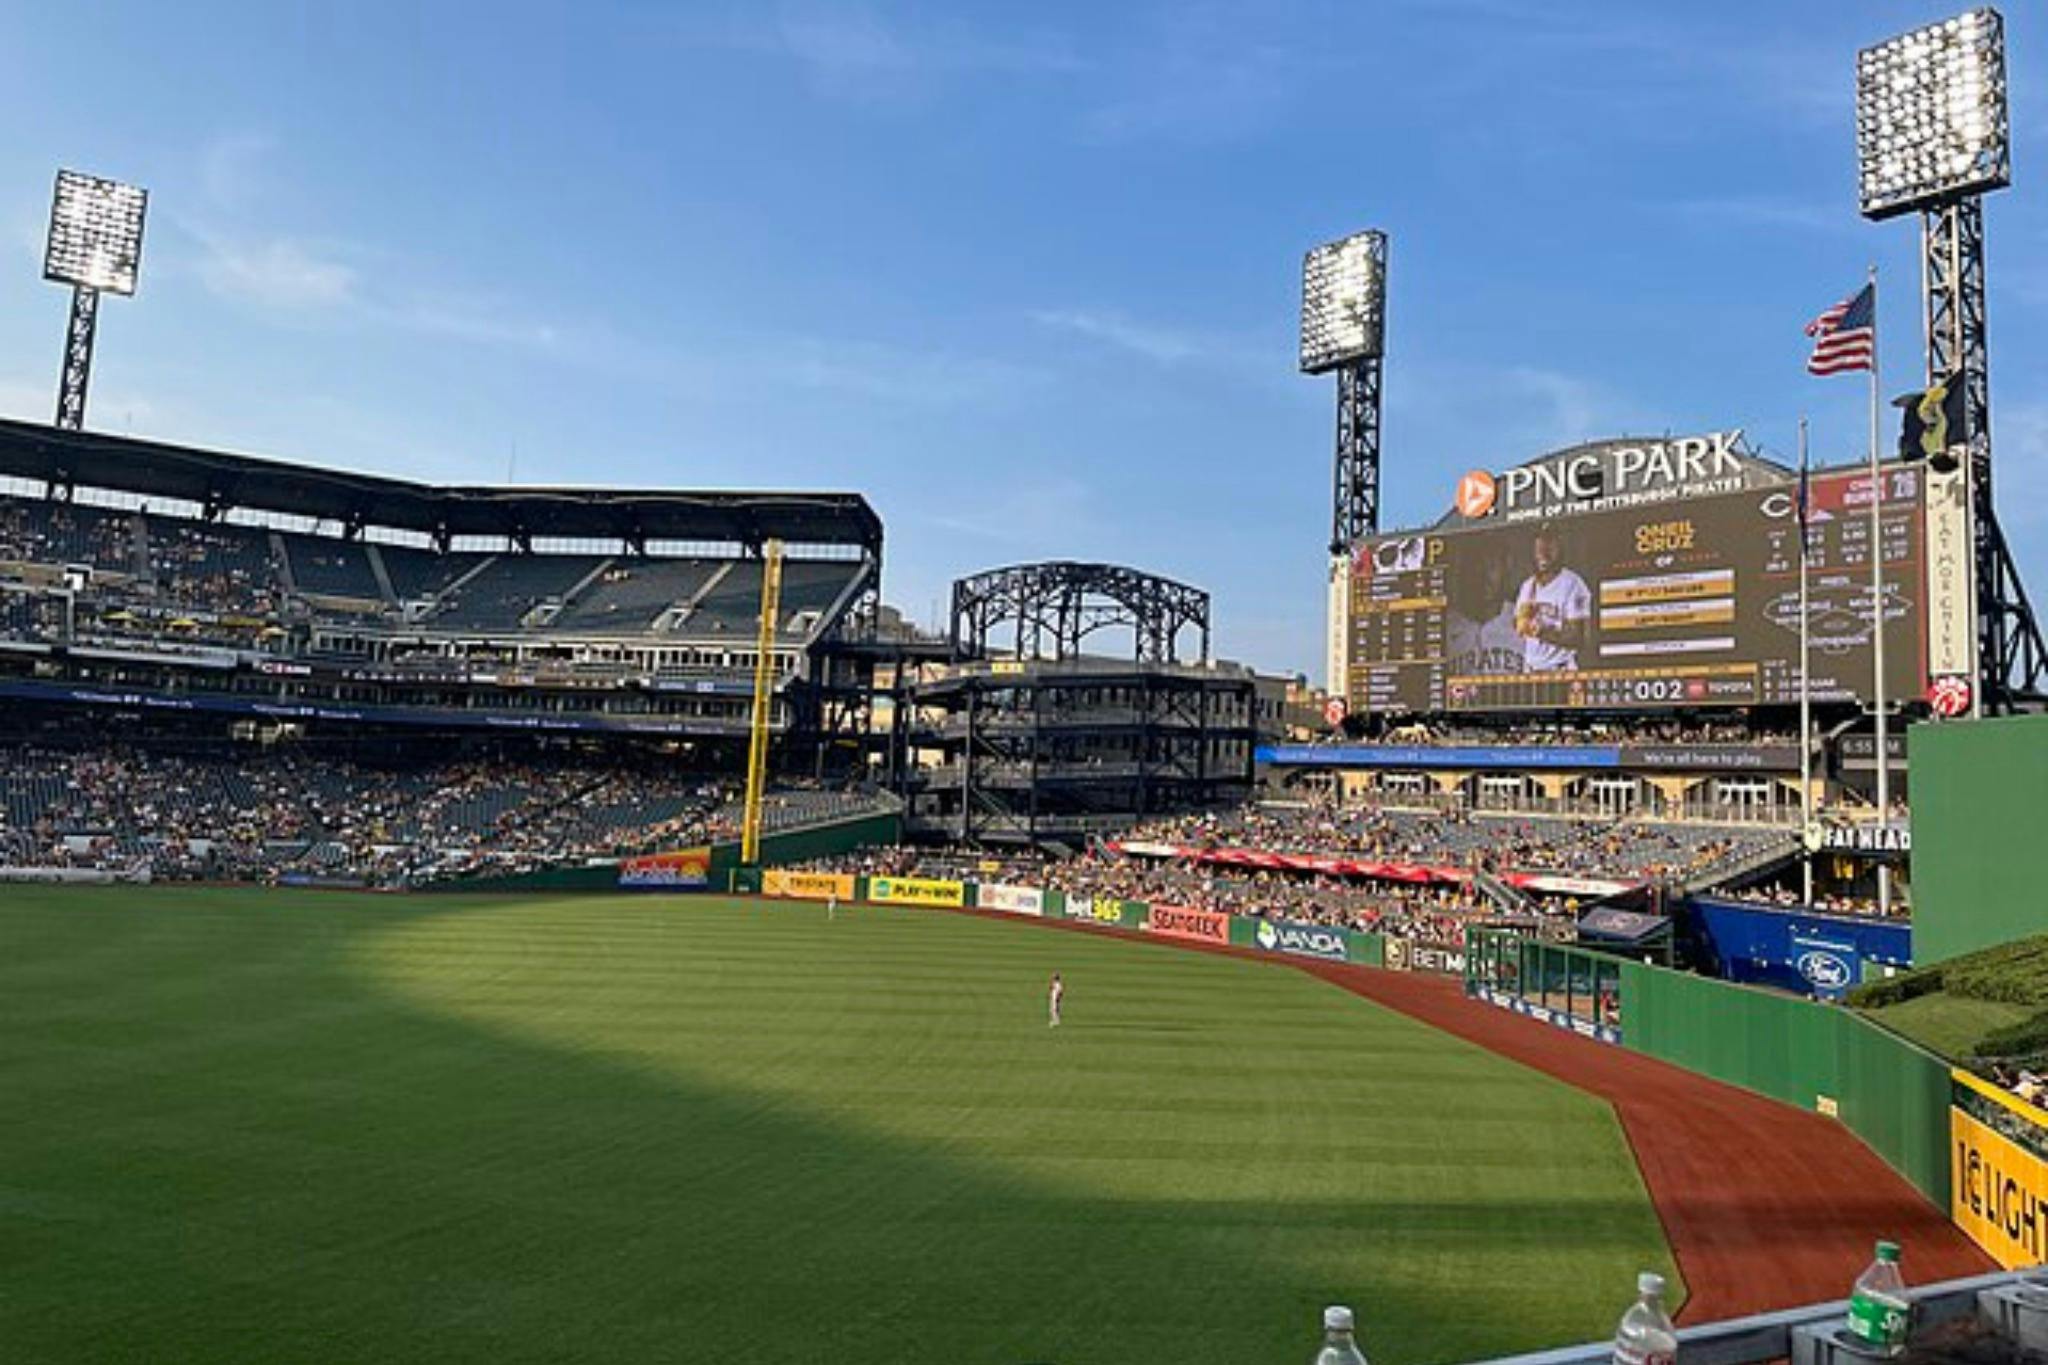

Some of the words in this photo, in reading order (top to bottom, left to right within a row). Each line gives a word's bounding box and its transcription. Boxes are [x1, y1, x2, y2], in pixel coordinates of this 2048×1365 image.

[1504, 455, 1600, 507] PNC
[1613, 429, 1743, 489] PARK
[1153, 908, 1224, 939] SEATGEEK
[1276, 928, 1346, 953] VANDA
